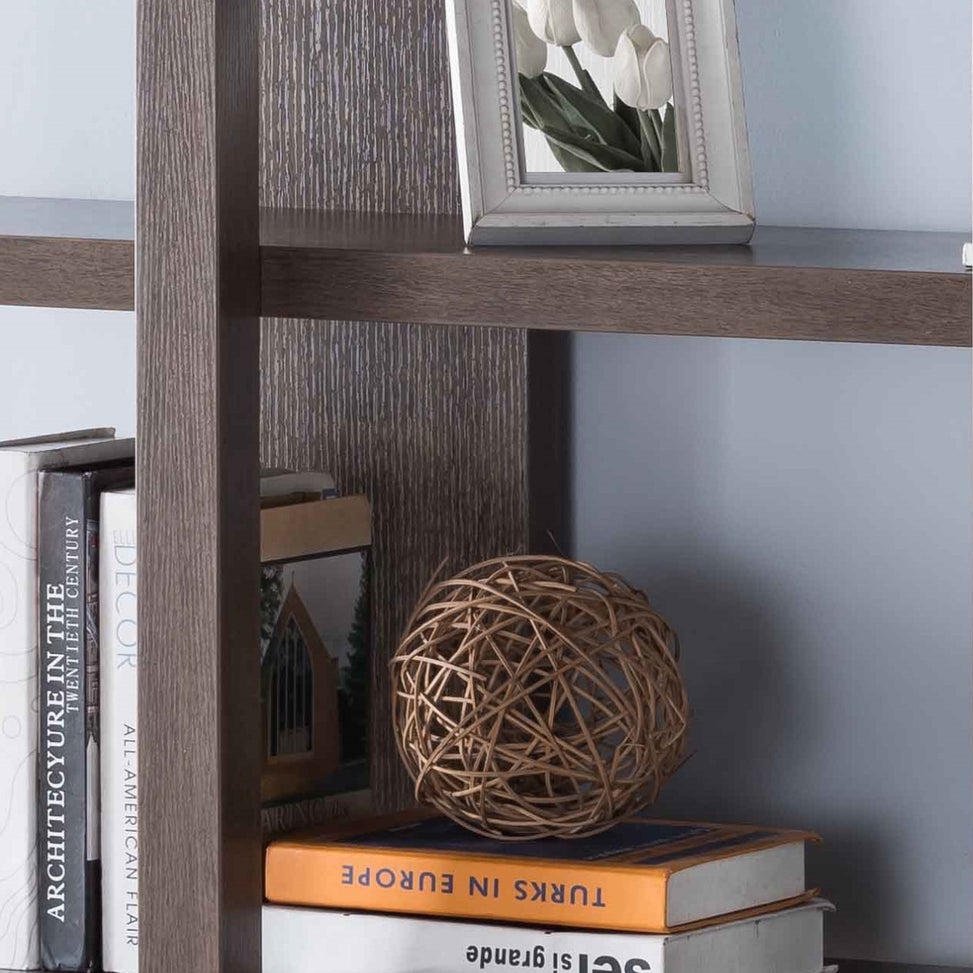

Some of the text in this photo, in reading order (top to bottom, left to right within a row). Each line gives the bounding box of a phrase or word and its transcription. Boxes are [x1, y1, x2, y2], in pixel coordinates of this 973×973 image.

[66, 516, 79, 713] TWENTIETH CENTURY
[114, 544, 137, 669] DECOR
[47, 583, 65, 923] ARCHITECYURE IN THE
[123, 723, 139, 946] ALL-AMERICAN FLAIR
[341, 864, 606, 908] TURKS IN EUROPE
[466, 945, 545, 970] grande
